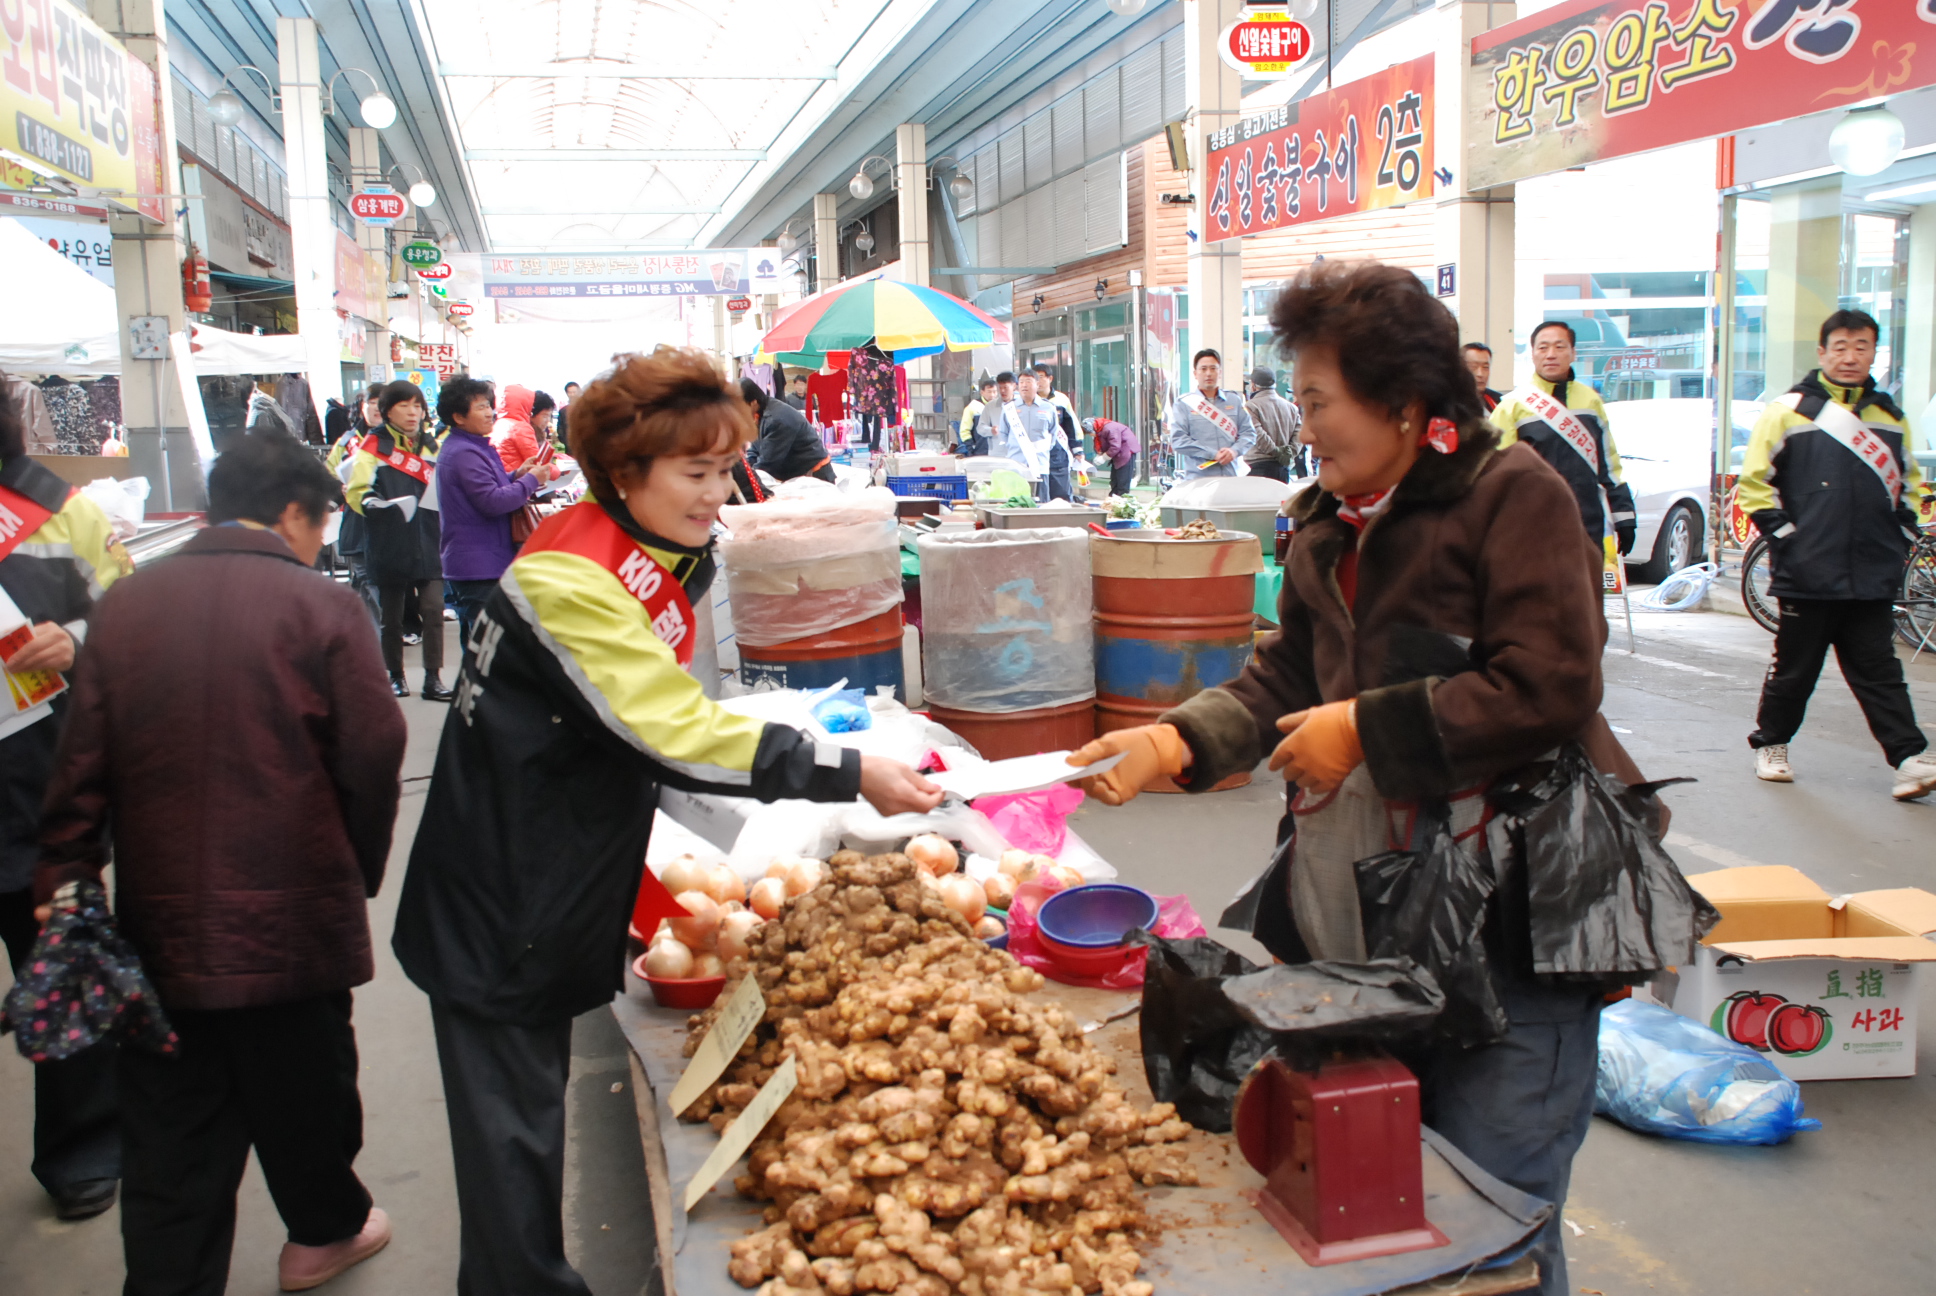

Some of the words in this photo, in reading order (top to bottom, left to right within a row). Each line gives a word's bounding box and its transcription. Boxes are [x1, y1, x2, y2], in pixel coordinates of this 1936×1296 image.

[1238, 27, 1302, 57] 신일숯불구이
[1255, 63, 1285, 72] 암소한우
[1495, 0, 1735, 143] 한우암소
[1210, 125, 1235, 151] 생등심
[1243, 107, 1288, 139] 생고기전문
[1209, 114, 1359, 231] 신일숯불구이
[1377, 91, 1422, 192] 2층
[12, 196, 77, 213] 836-0188
[1441, 274, 1451, 290] 41
[419, 345, 454, 362] 반찬
[410, 372, 424, 386] 생
[1198, 401, 1218, 420] 화재를
[1525, 392, 1559, 420] 화재를
[1851, 430, 1889, 469] 화재를
[1851, 1007, 1904, 1033] 사과
